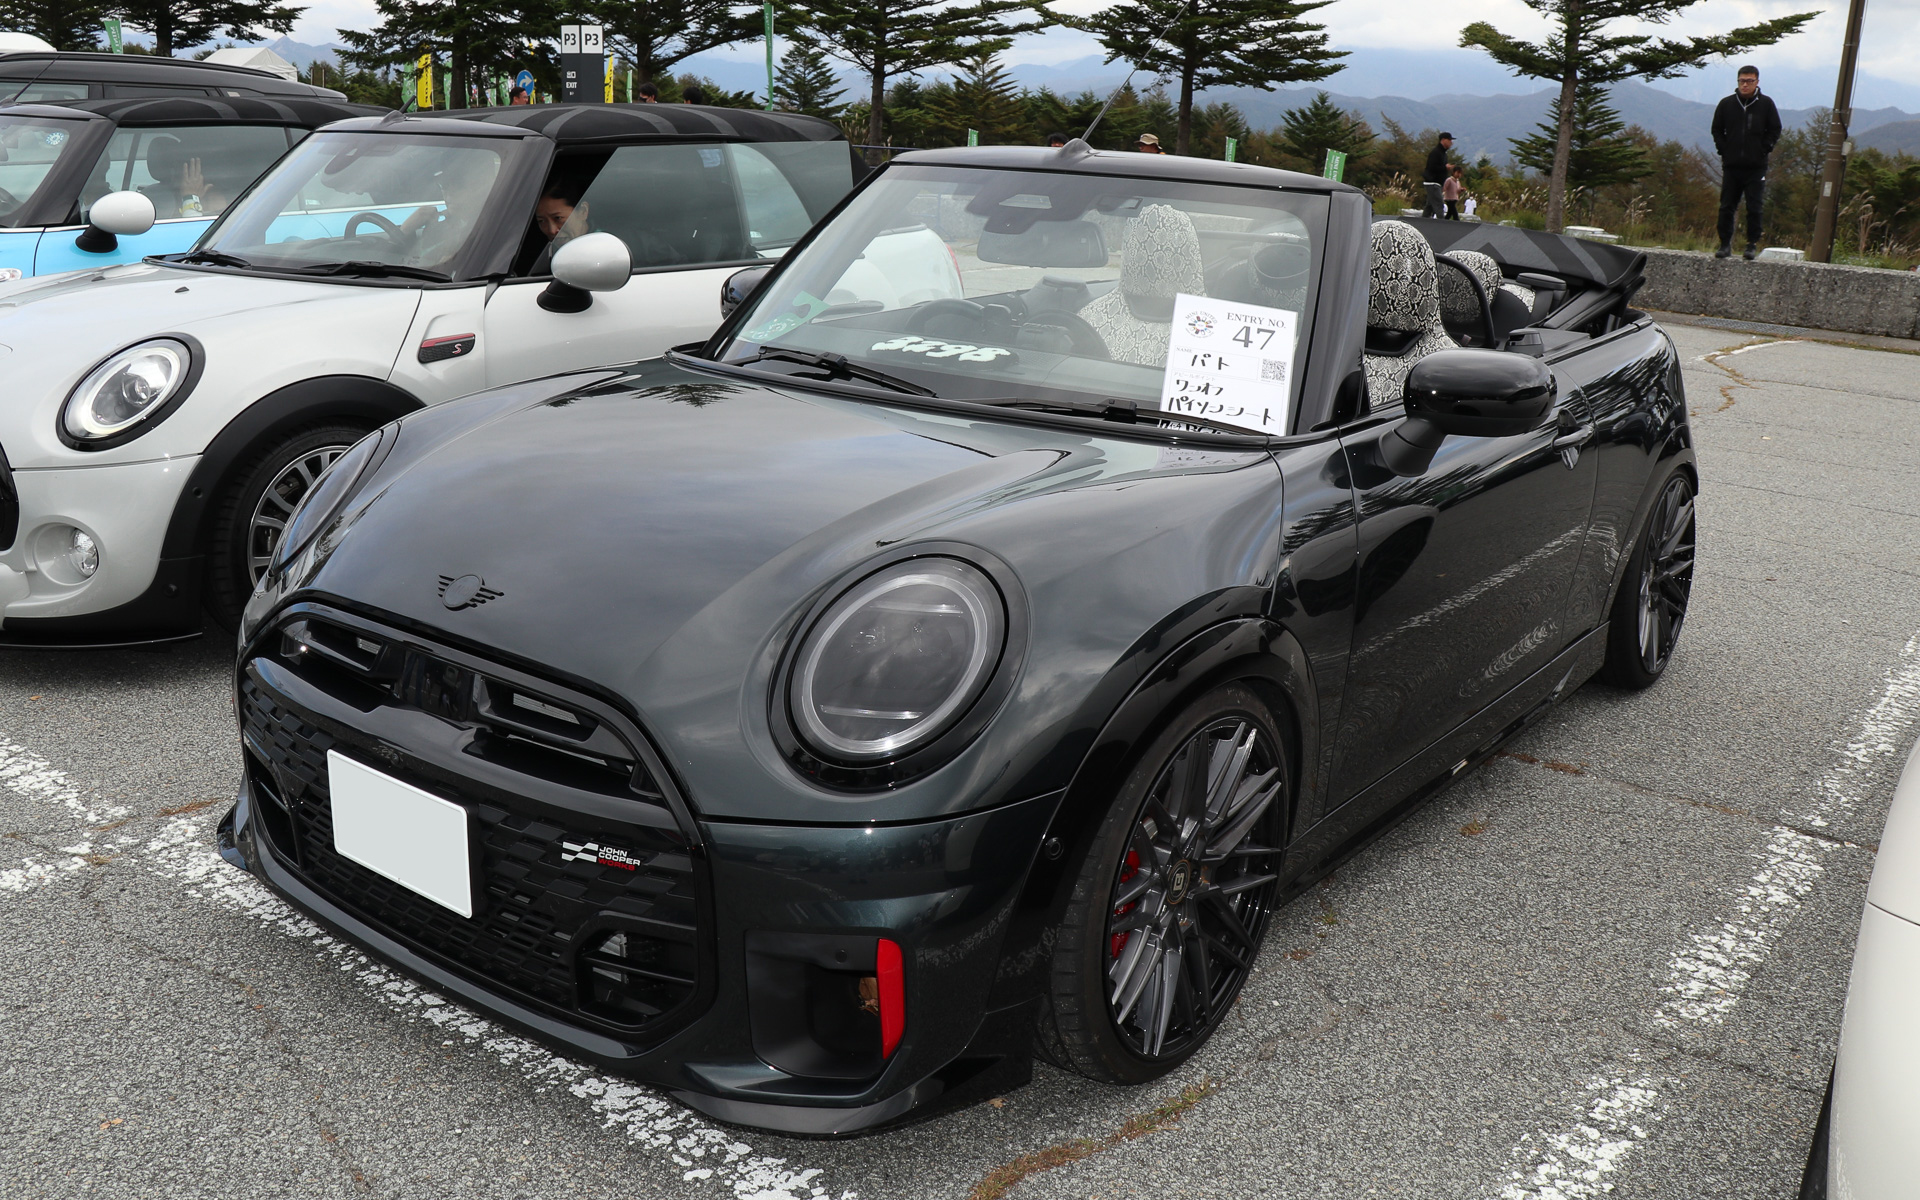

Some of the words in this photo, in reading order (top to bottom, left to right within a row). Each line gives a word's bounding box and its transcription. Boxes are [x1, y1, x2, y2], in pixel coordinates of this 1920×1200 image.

[564, 33, 576, 45] P3
[585, 33, 599, 45] P3
[1185, 311, 1198, 320] MINI
[1199, 311, 1218, 324] UNITED
[1227, 312, 1265, 325] ENTRY
[1268, 318, 1287, 329] NO.
[1232, 326, 1276, 350] 47
[452, 343, 462, 354] S
[1176, 379, 1223, 396] ワンオフ
[1168, 395, 1276, 425] パイソンシート
[599, 846, 628, 857] JOHN
[598, 852, 641, 866] COOPER
[598, 858, 635, 871] WORKS
